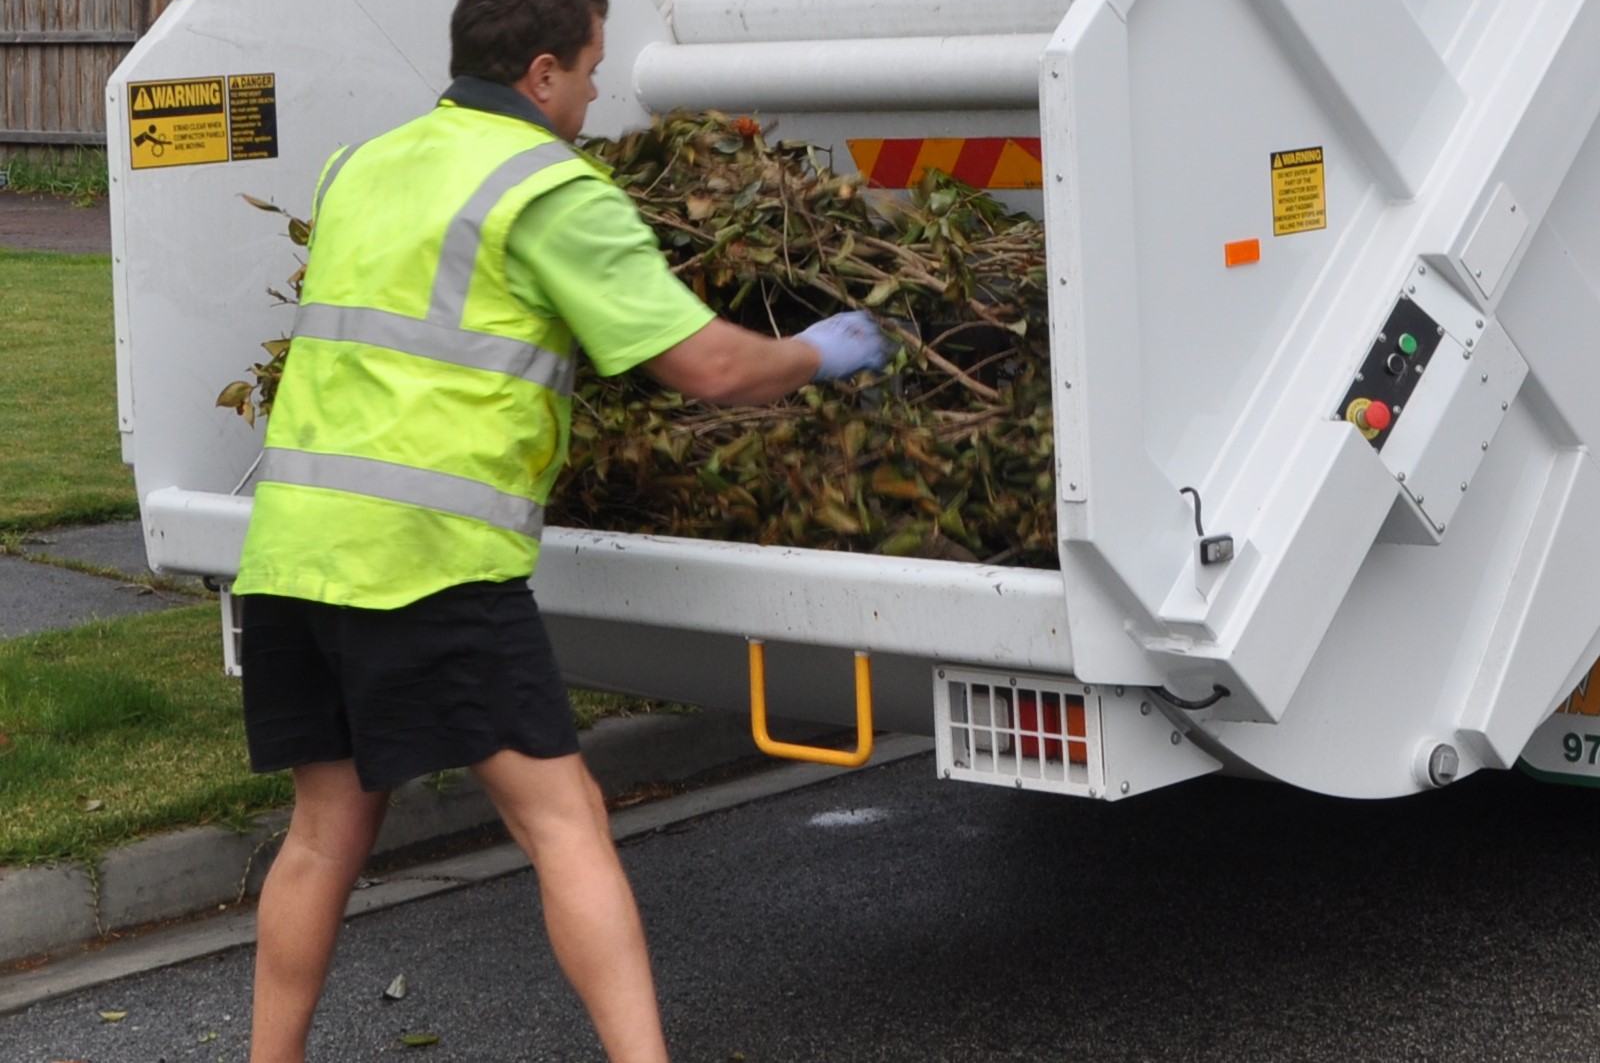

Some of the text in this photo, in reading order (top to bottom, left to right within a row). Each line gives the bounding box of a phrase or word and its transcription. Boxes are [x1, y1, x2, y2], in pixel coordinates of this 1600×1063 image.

[241, 76, 272, 87] DANGER
[151, 83, 220, 109] WARNING
[1282, 150, 1321, 165] WARNING
